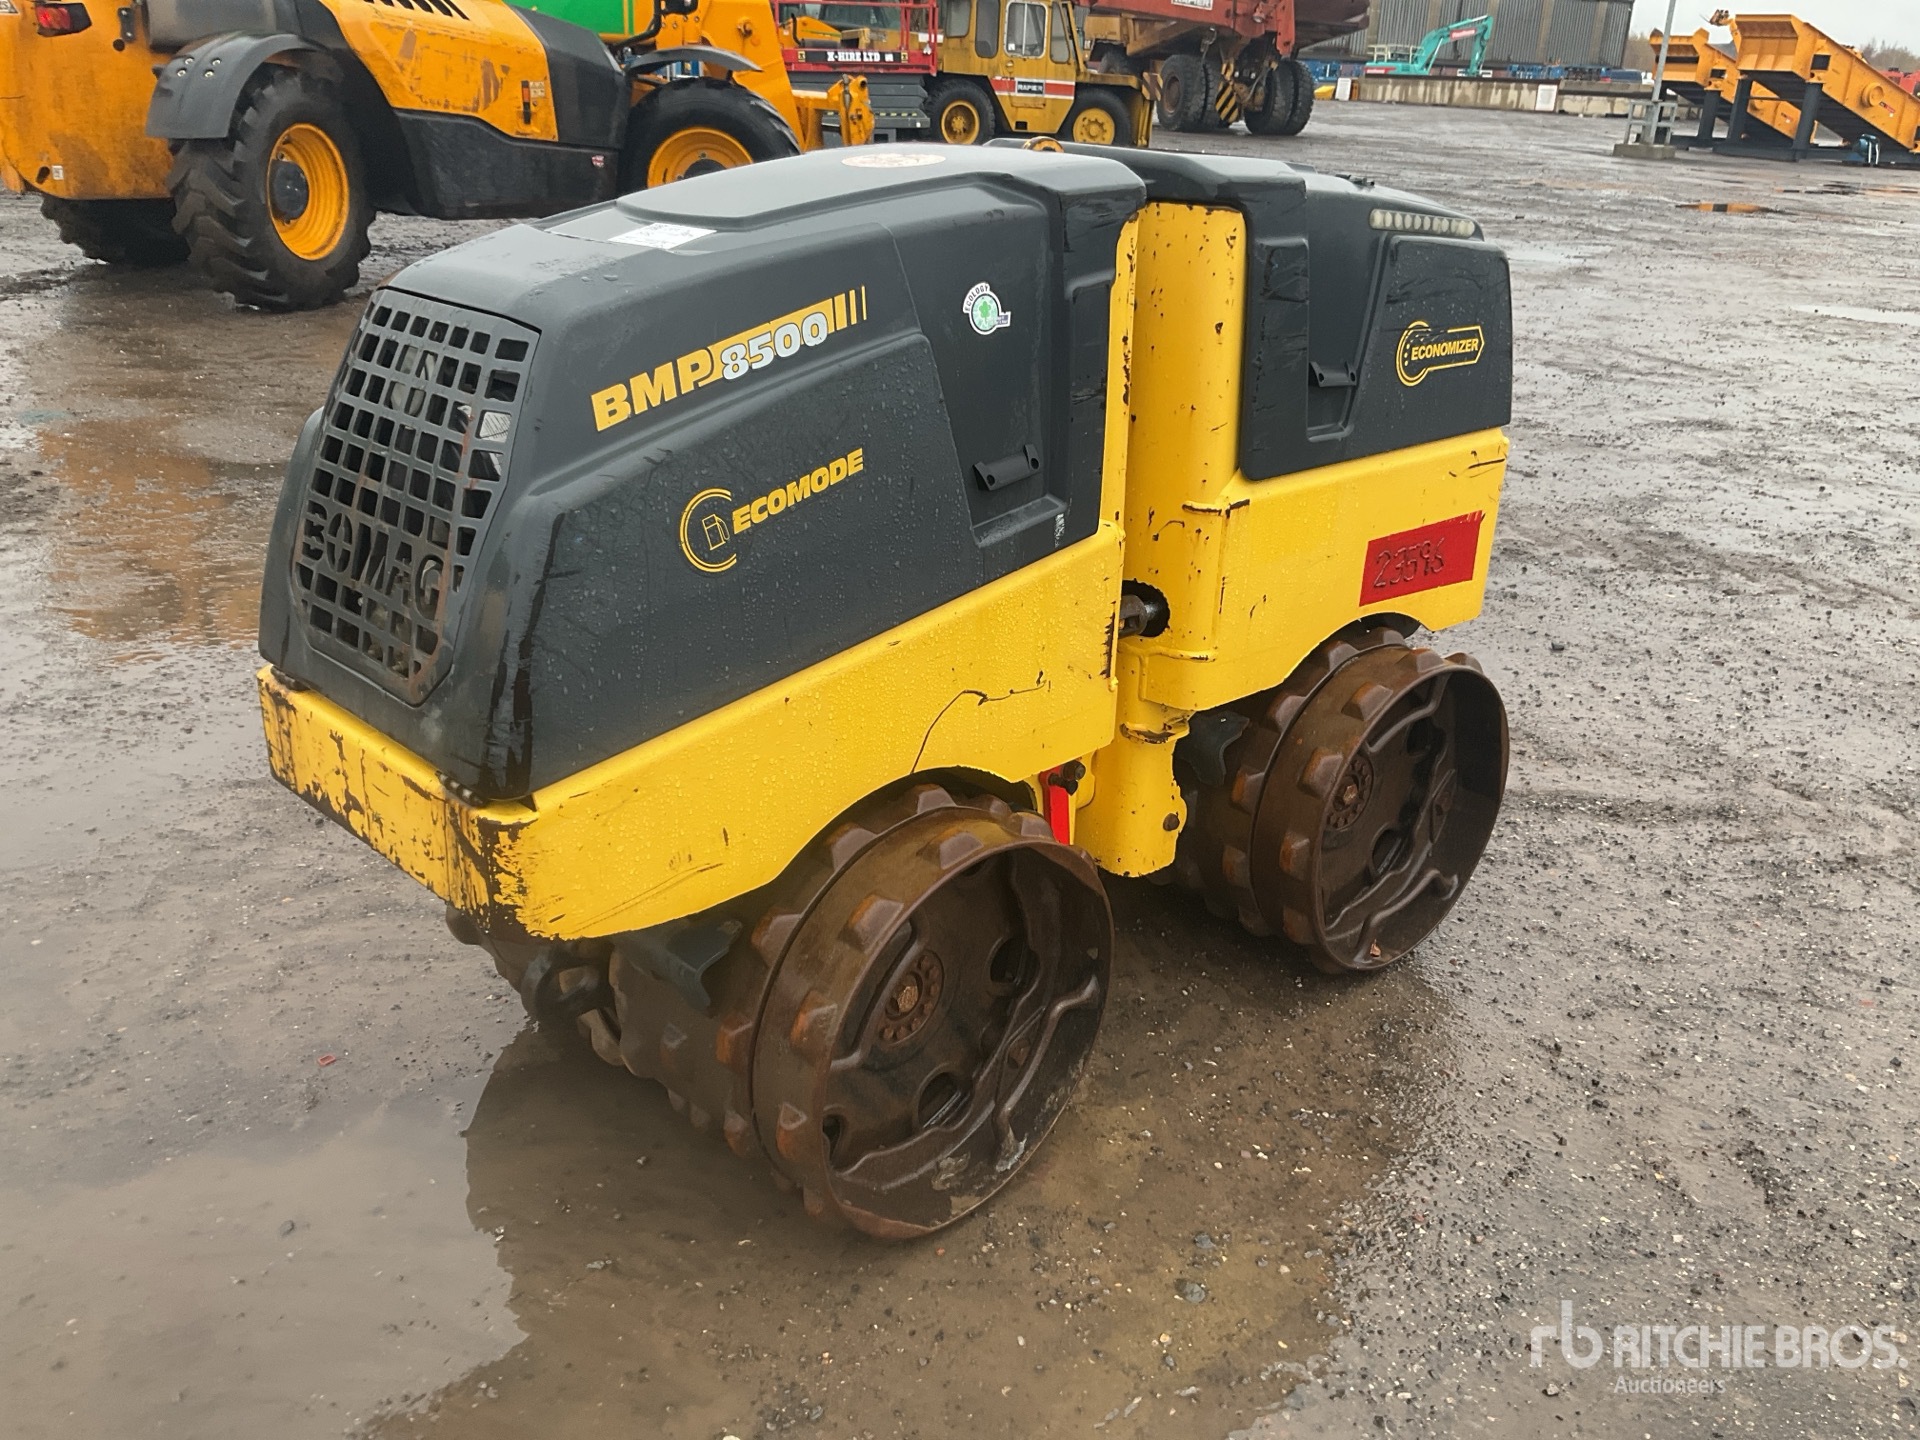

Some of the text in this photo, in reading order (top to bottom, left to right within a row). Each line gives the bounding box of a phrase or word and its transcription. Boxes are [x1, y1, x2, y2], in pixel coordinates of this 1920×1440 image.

[863, 51, 881, 62] LTD
[1017, 83, 1043, 92] RAPIER
[964, 284, 989, 311] ECOLOGY
[1411, 338, 1479, 361] ECONOMIZER
[591, 347, 714, 432] BMP
[720, 311, 829, 381] 8500
[732, 447, 864, 535] ECOMODE
[302, 500, 445, 622] BOMAG
[1373, 537, 1445, 588] 23596
